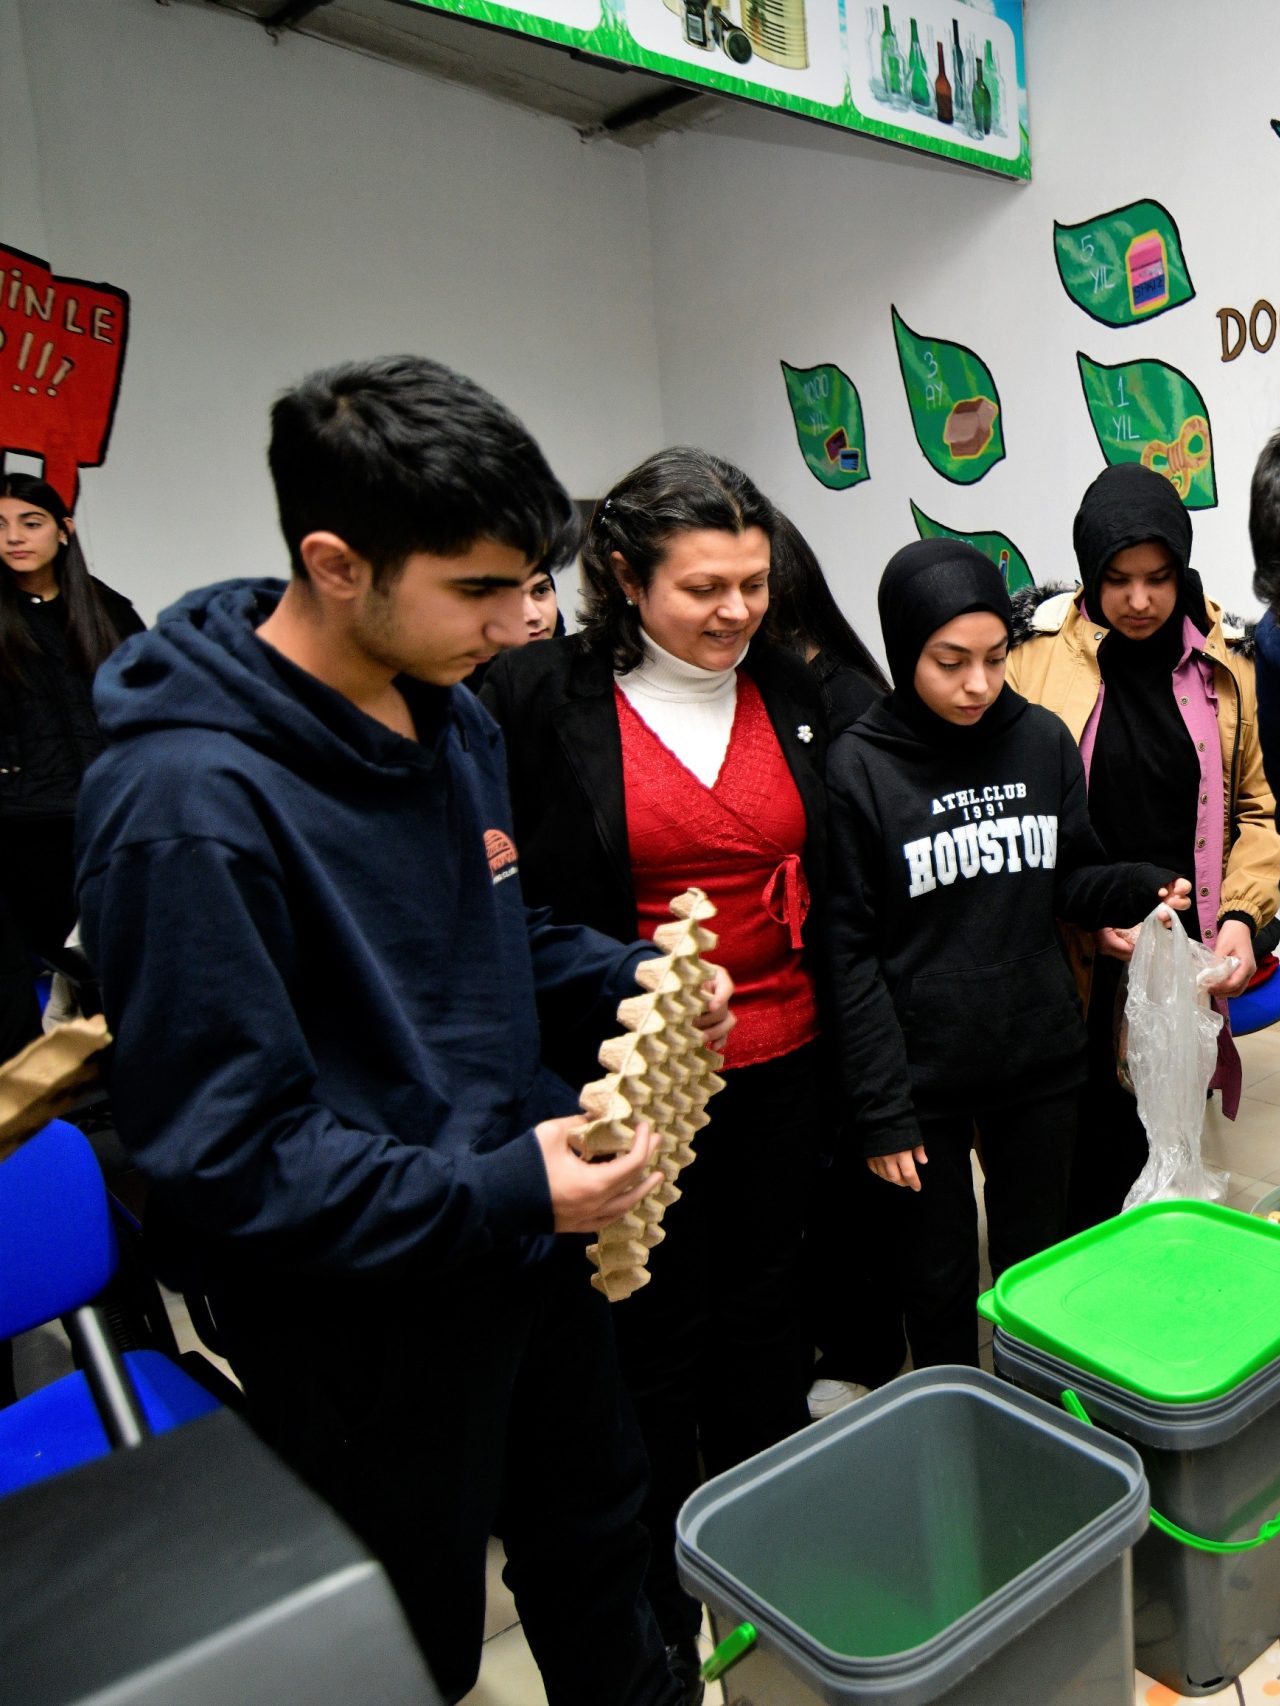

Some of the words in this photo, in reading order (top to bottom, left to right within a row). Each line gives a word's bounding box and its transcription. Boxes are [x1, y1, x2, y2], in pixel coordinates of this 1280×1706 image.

[1079, 234, 1095, 263] 5
[1089, 264, 1116, 294] YIL
[0, 268, 114, 344] İNLE
[922, 350, 939, 379] 3
[924, 380, 944, 411] AY
[1117, 375, 1130, 408] 1
[1112, 414, 1140, 442] YIL
[932, 782, 1027, 815] ATHL.CLUB
[903, 814, 1058, 898] HOUSTON
